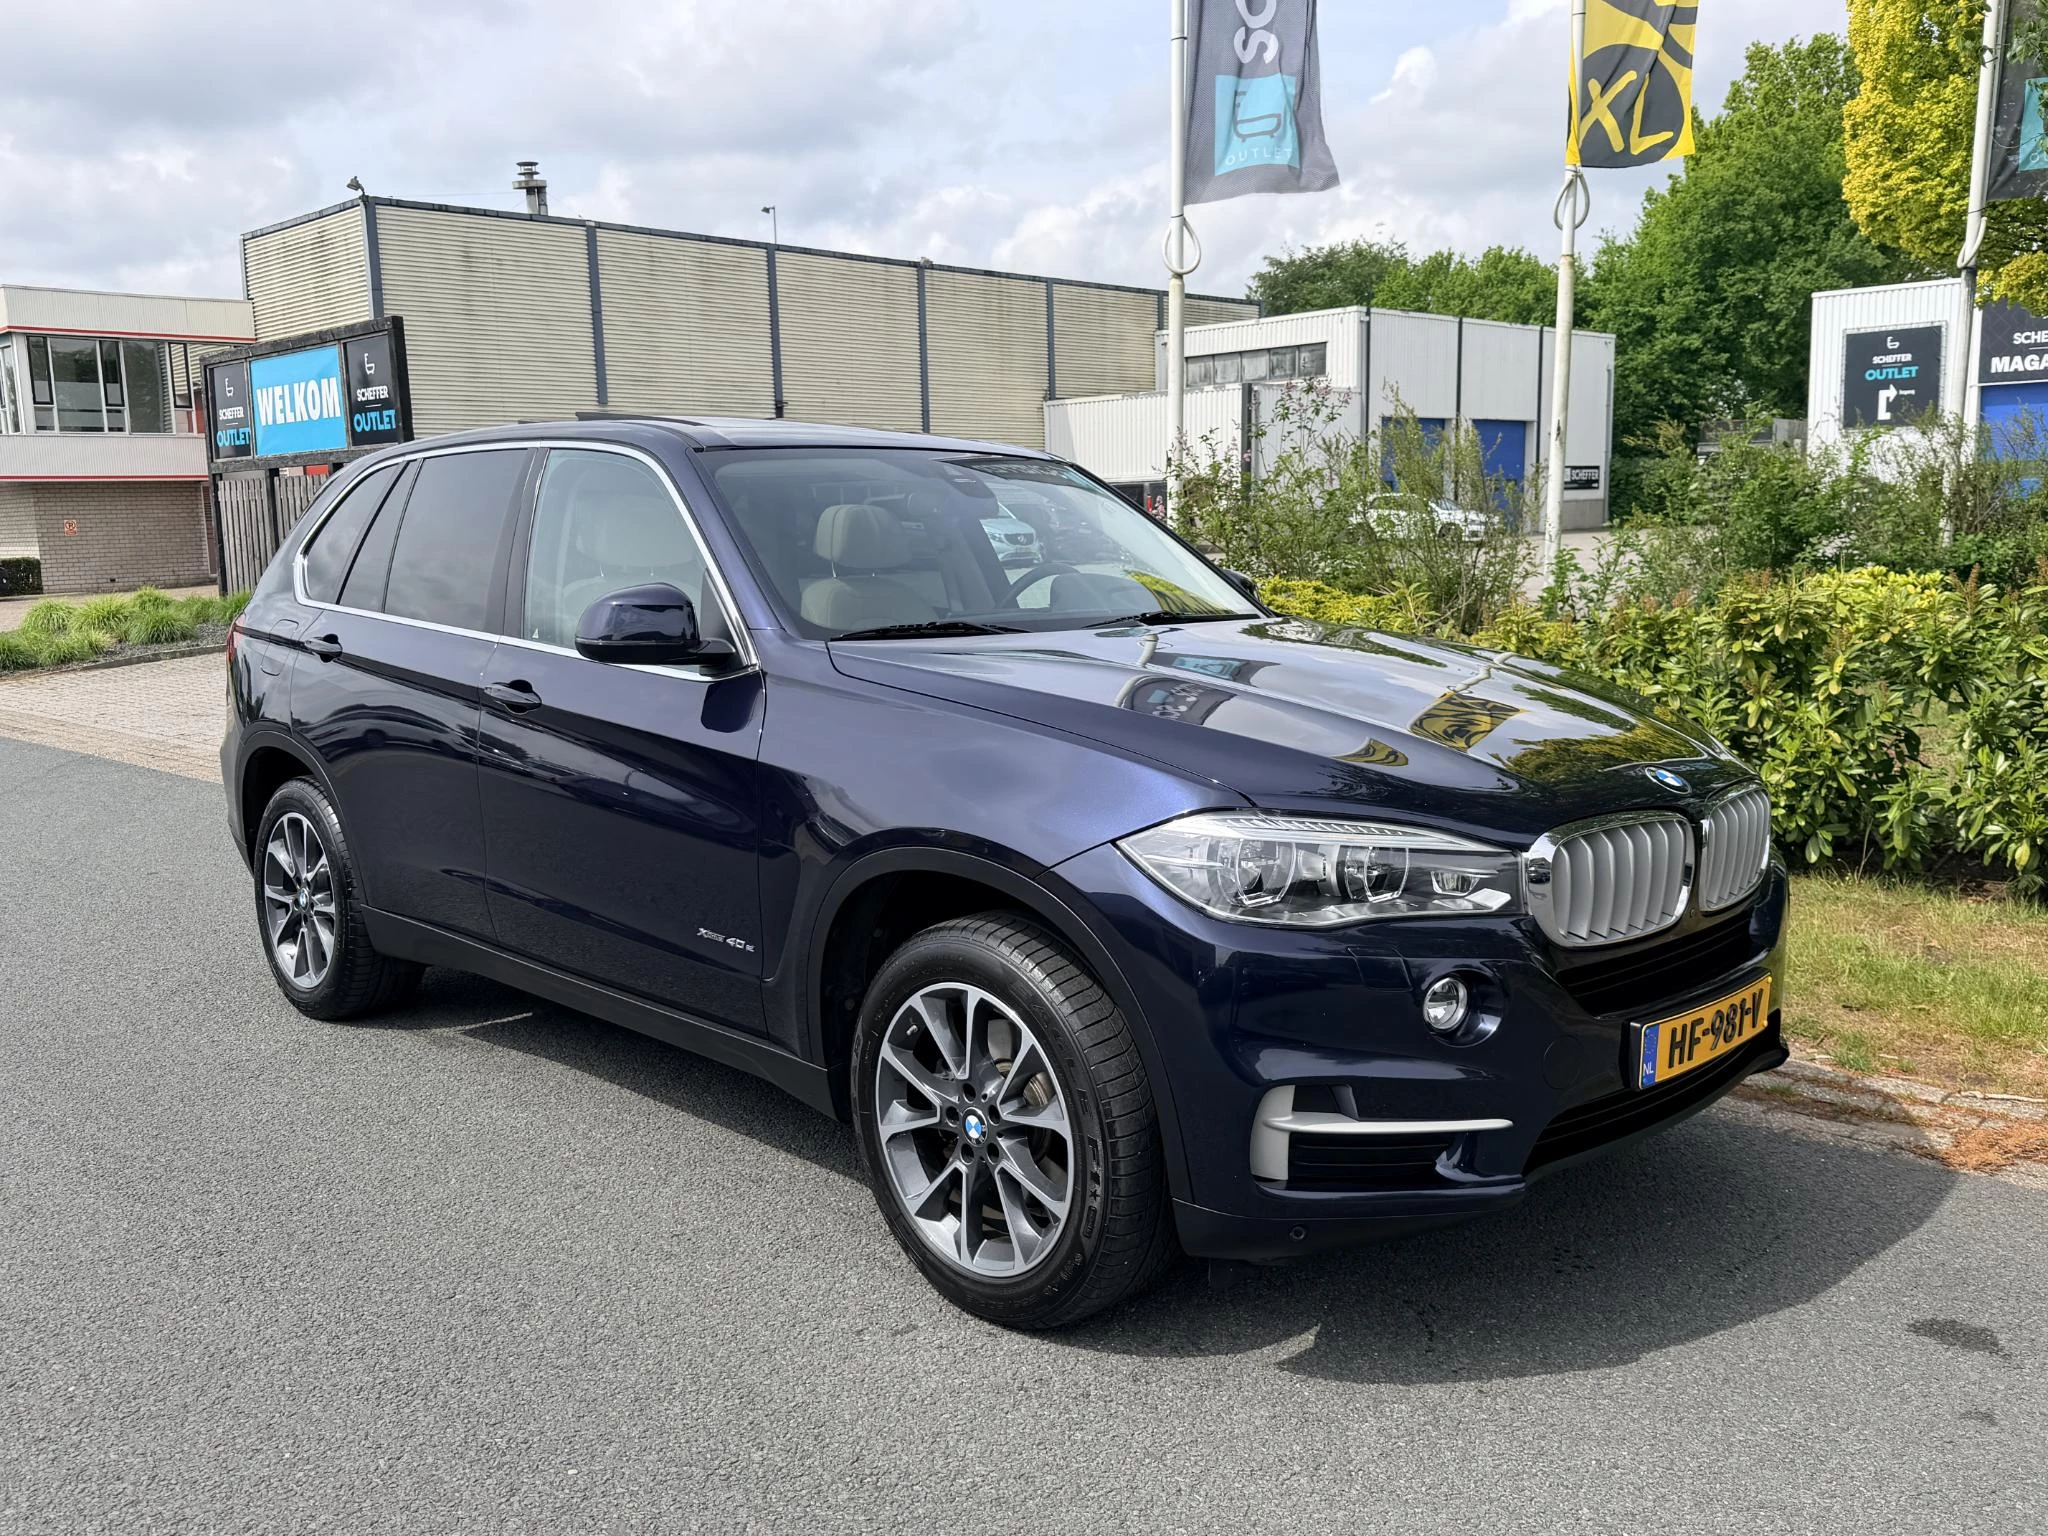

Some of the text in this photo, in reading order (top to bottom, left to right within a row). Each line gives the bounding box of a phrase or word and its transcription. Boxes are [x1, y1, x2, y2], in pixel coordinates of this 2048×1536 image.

[1579, 70, 1674, 155] XL
[1225, 148, 1293, 166] OUTLET
[1872, 353, 1912, 365] SCHEFFER
[1865, 366, 1919, 381] OUTLET
[256, 376, 341, 426] WELKOM
[356, 385, 389, 402] SCHEFFER
[218, 406, 245, 420] SCHEFFER
[353, 409, 396, 433] OUTLET
[216, 427, 250, 447] OUTLET
[1571, 469, 1599, 481] SCHEFFER
[1668, 988, 1764, 1069] HF-981-V
[1643, 1063, 1655, 1076] NL
